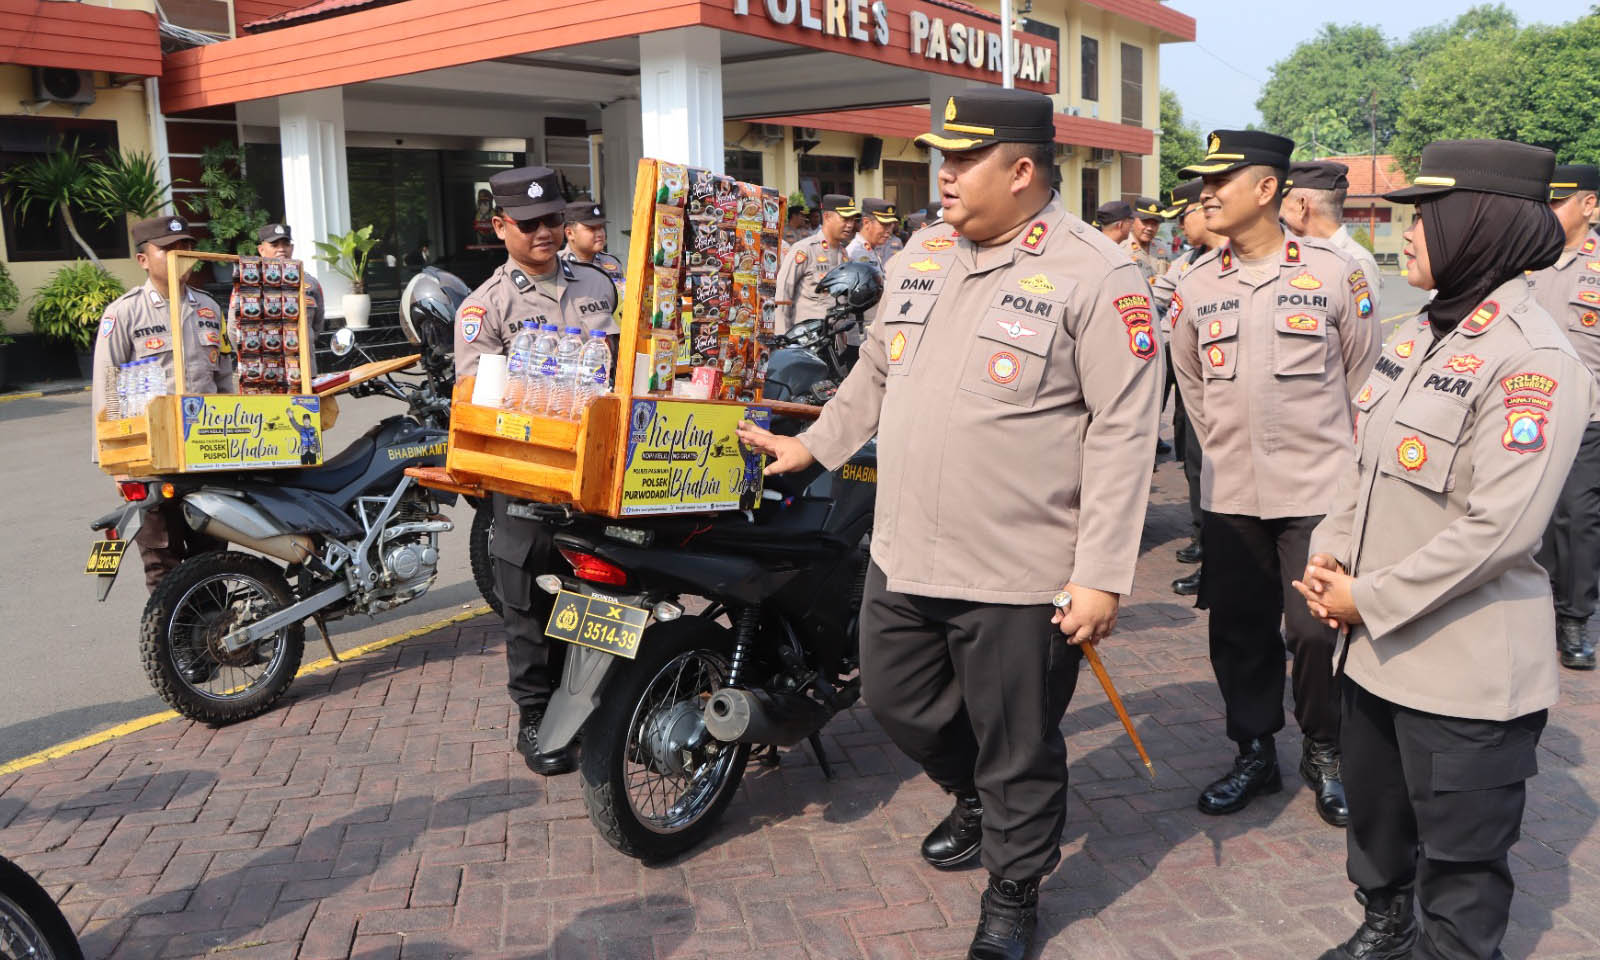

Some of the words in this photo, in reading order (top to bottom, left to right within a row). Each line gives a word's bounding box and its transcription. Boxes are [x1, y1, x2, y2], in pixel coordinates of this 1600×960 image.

[900, 278, 934, 291] DANI
[580, 301, 610, 314] POLRI
[1001, 294, 1052, 317] POLRI
[1197, 304, 1217, 317] TULUS
[1220, 299, 1239, 312] ADHI
[1277, 294, 1327, 308] POLRI
[134, 324, 167, 338] STEVEN
[508, 315, 547, 334] BAUS
[1424, 374, 1473, 398] POLRI
[1505, 374, 1554, 388] POLRES
[202, 402, 263, 438] Kopling
[648, 412, 714, 467] Kopling
[230, 437, 278, 461] Bhabin
[642, 478, 668, 487] POLSEK
[671, 467, 720, 502] Bhabin
[624, 490, 668, 500] PURWODADI
[591, 592, 618, 603] HONDA
[606, 606, 623, 619] X
[584, 621, 637, 650] 3514-39
